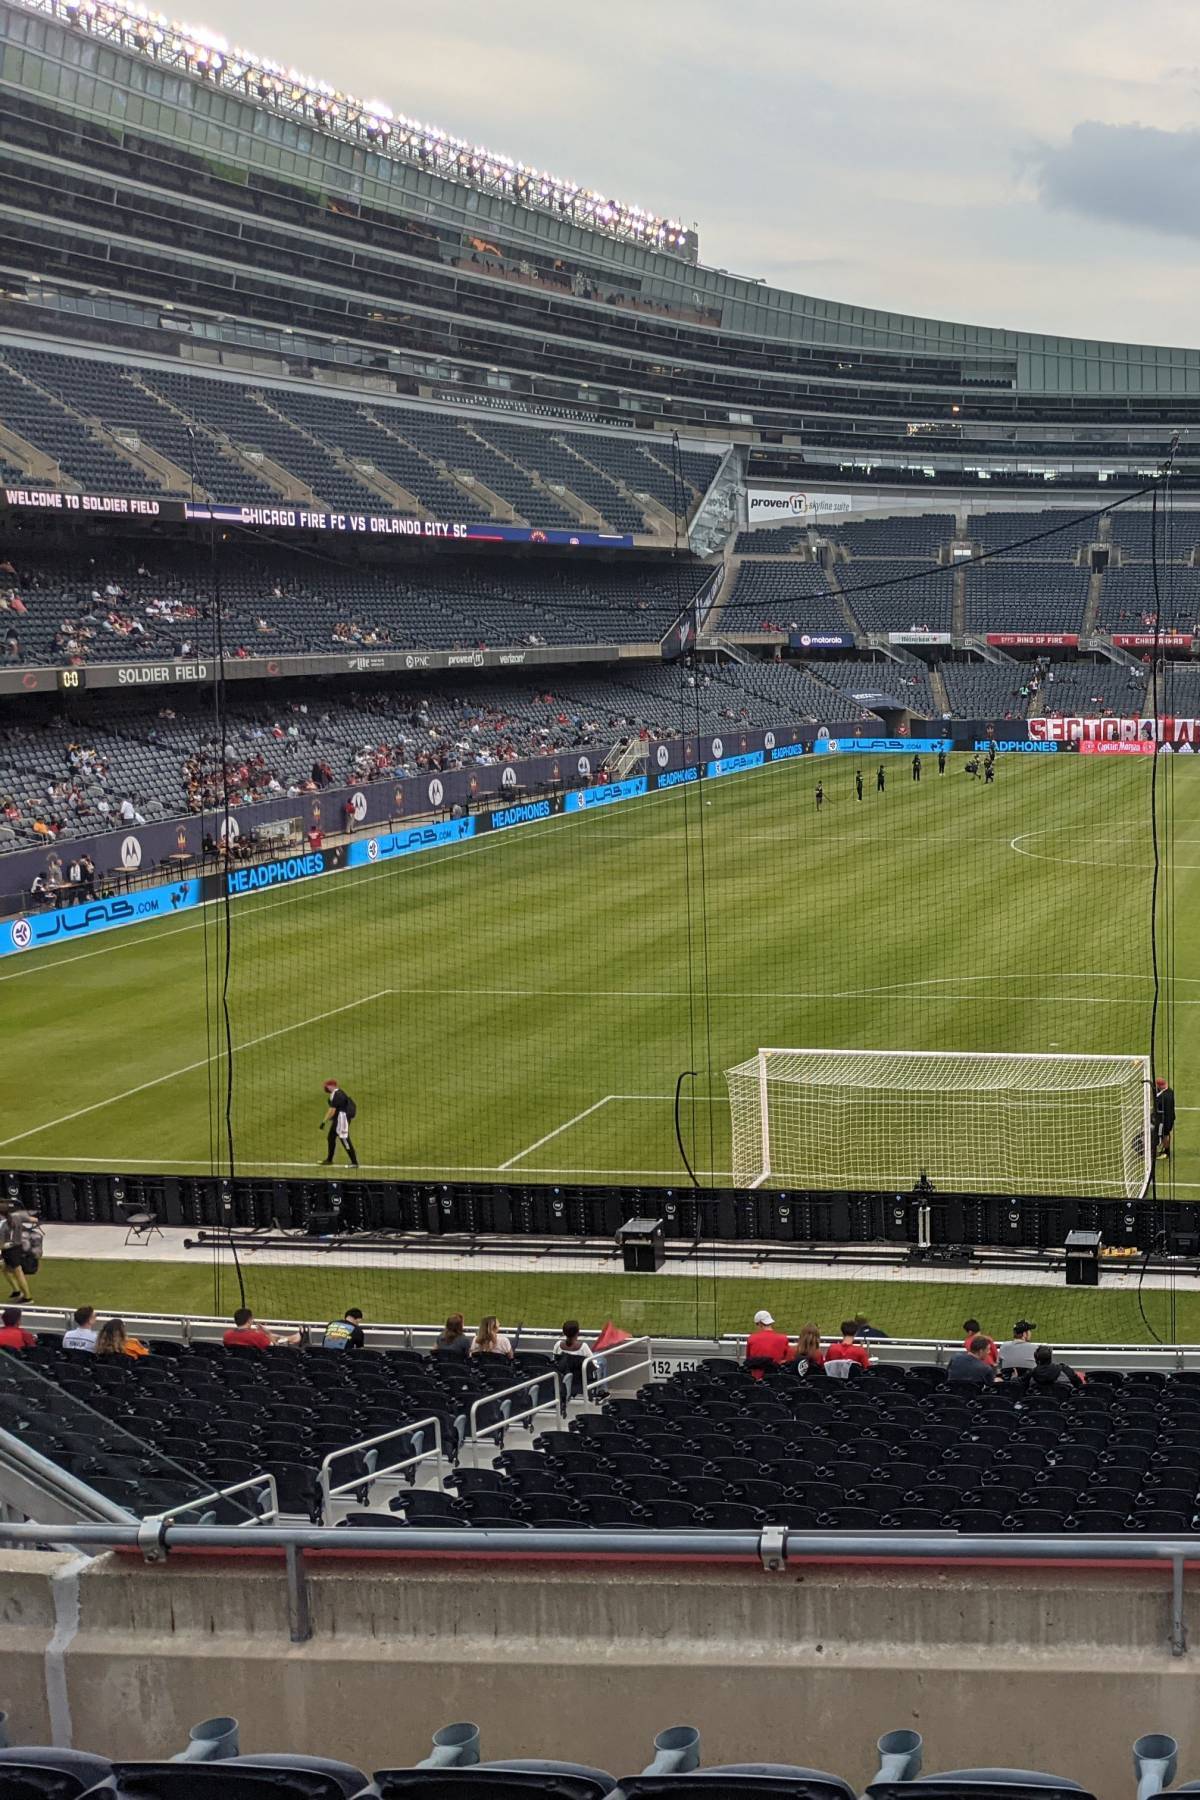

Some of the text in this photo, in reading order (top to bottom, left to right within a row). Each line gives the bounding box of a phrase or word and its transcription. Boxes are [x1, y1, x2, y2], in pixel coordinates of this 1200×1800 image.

[6, 490, 160, 515] WELCOME TO SOLDIER FIELD
[751, 498, 789, 508] proven
[794, 500, 803, 508] IT
[809, 501, 832, 511] skyline
[241, 508, 467, 538] CHICAGO FIRE FC VS ORLANDO CITY SC
[414, 656, 431, 667] PNC
[449, 655, 472, 667] proven
[118, 665, 207, 684] SOLDIER FIELD
[771, 744, 803, 760] HEADPHONES
[491, 800, 550, 828] HEADPHONES
[228, 854, 324, 893] HEADPHONES
[651, 1361, 697, 1374] 152 151
